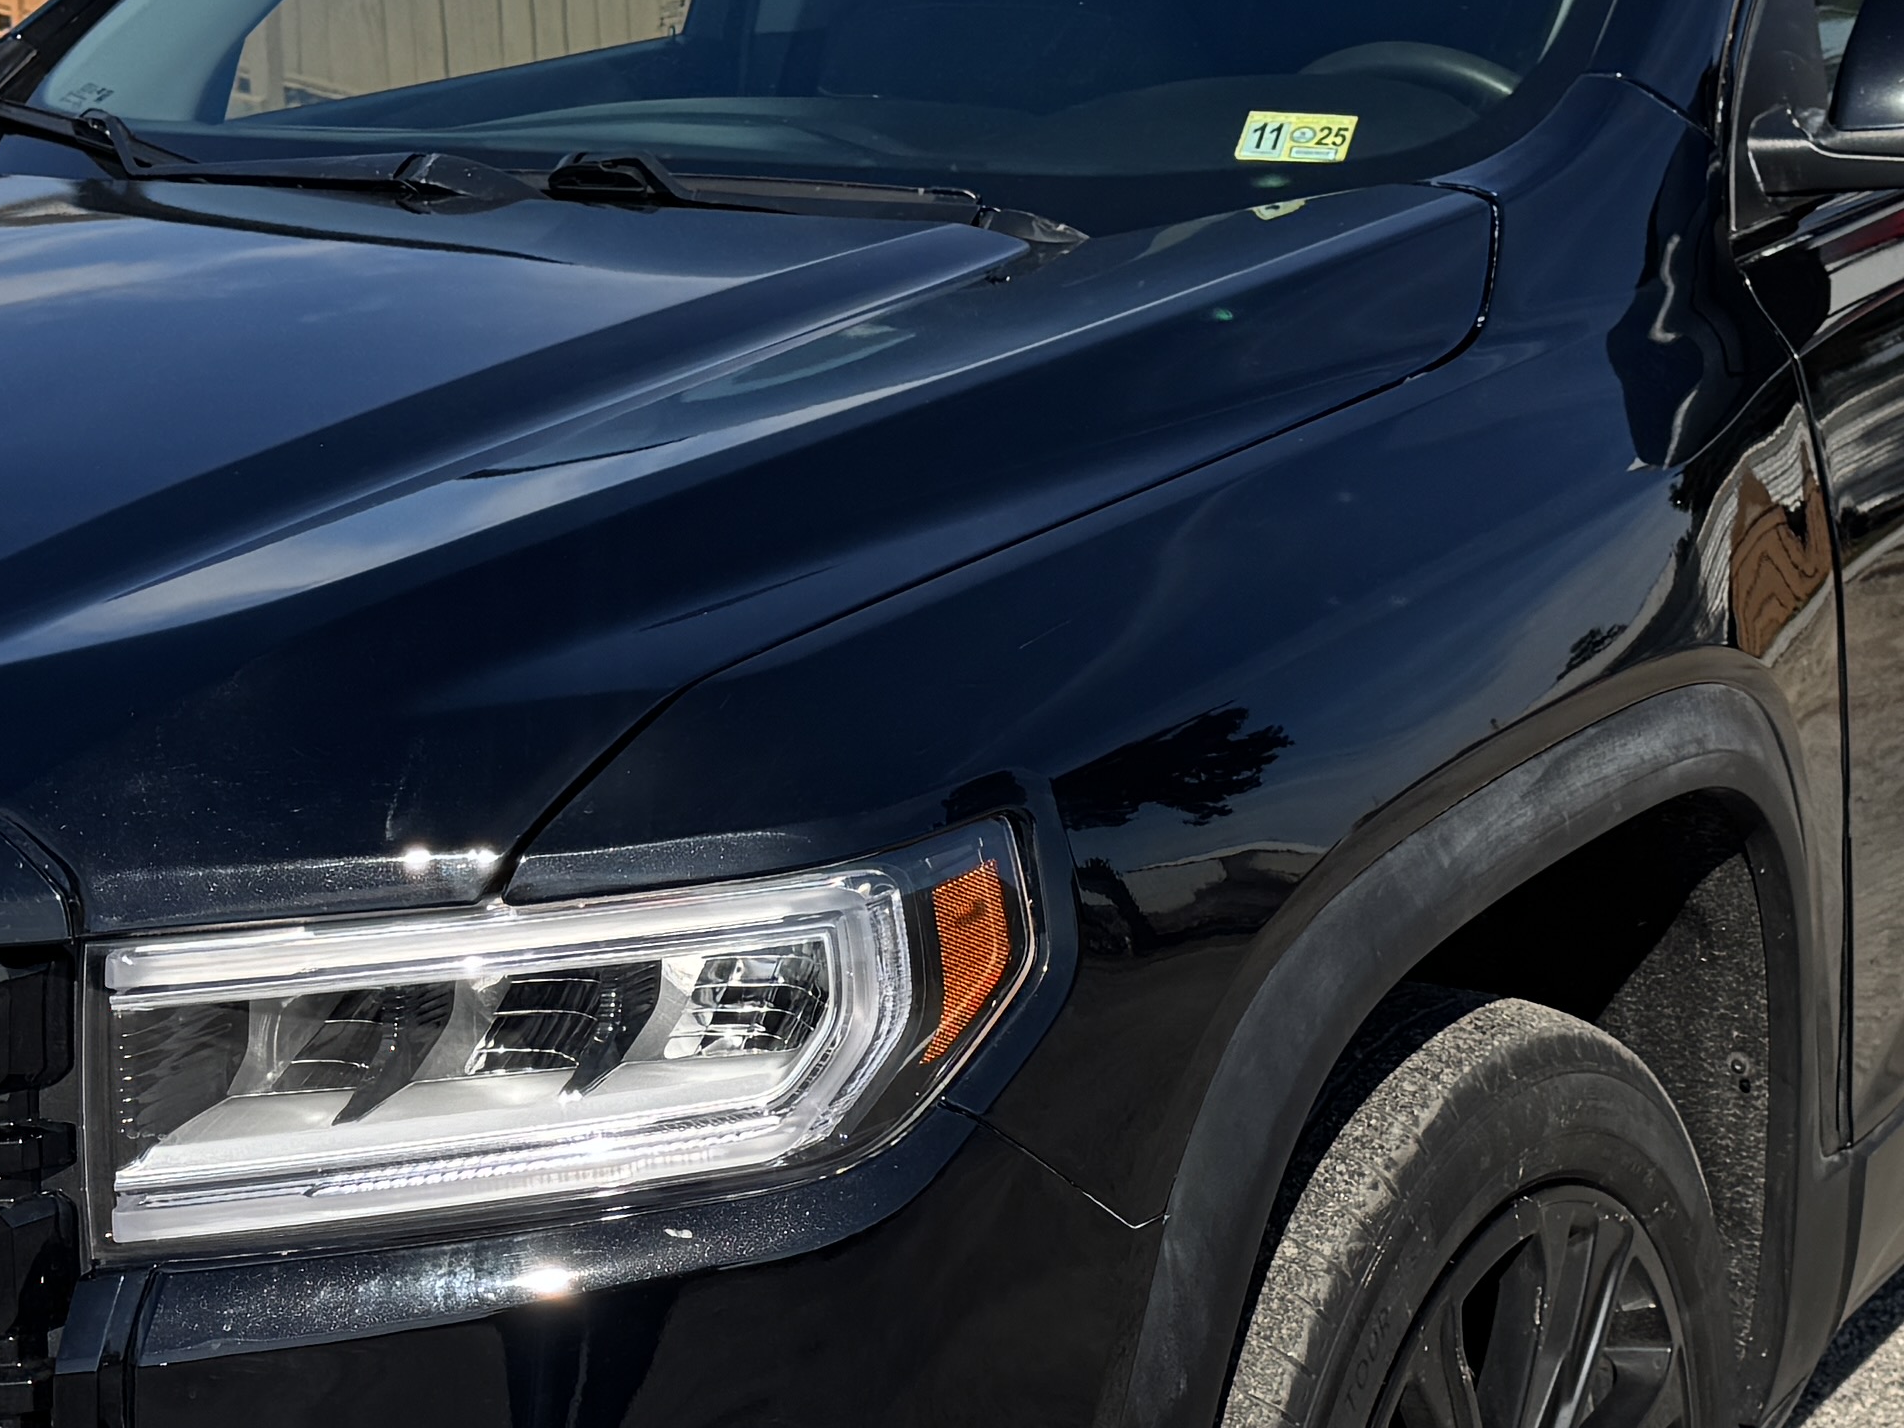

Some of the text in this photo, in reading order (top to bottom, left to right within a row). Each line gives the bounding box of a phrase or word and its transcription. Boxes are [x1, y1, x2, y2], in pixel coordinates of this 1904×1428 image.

[1253, 122, 1349, 151] 11 25
[1344, 1305, 1391, 1413] TOUR
